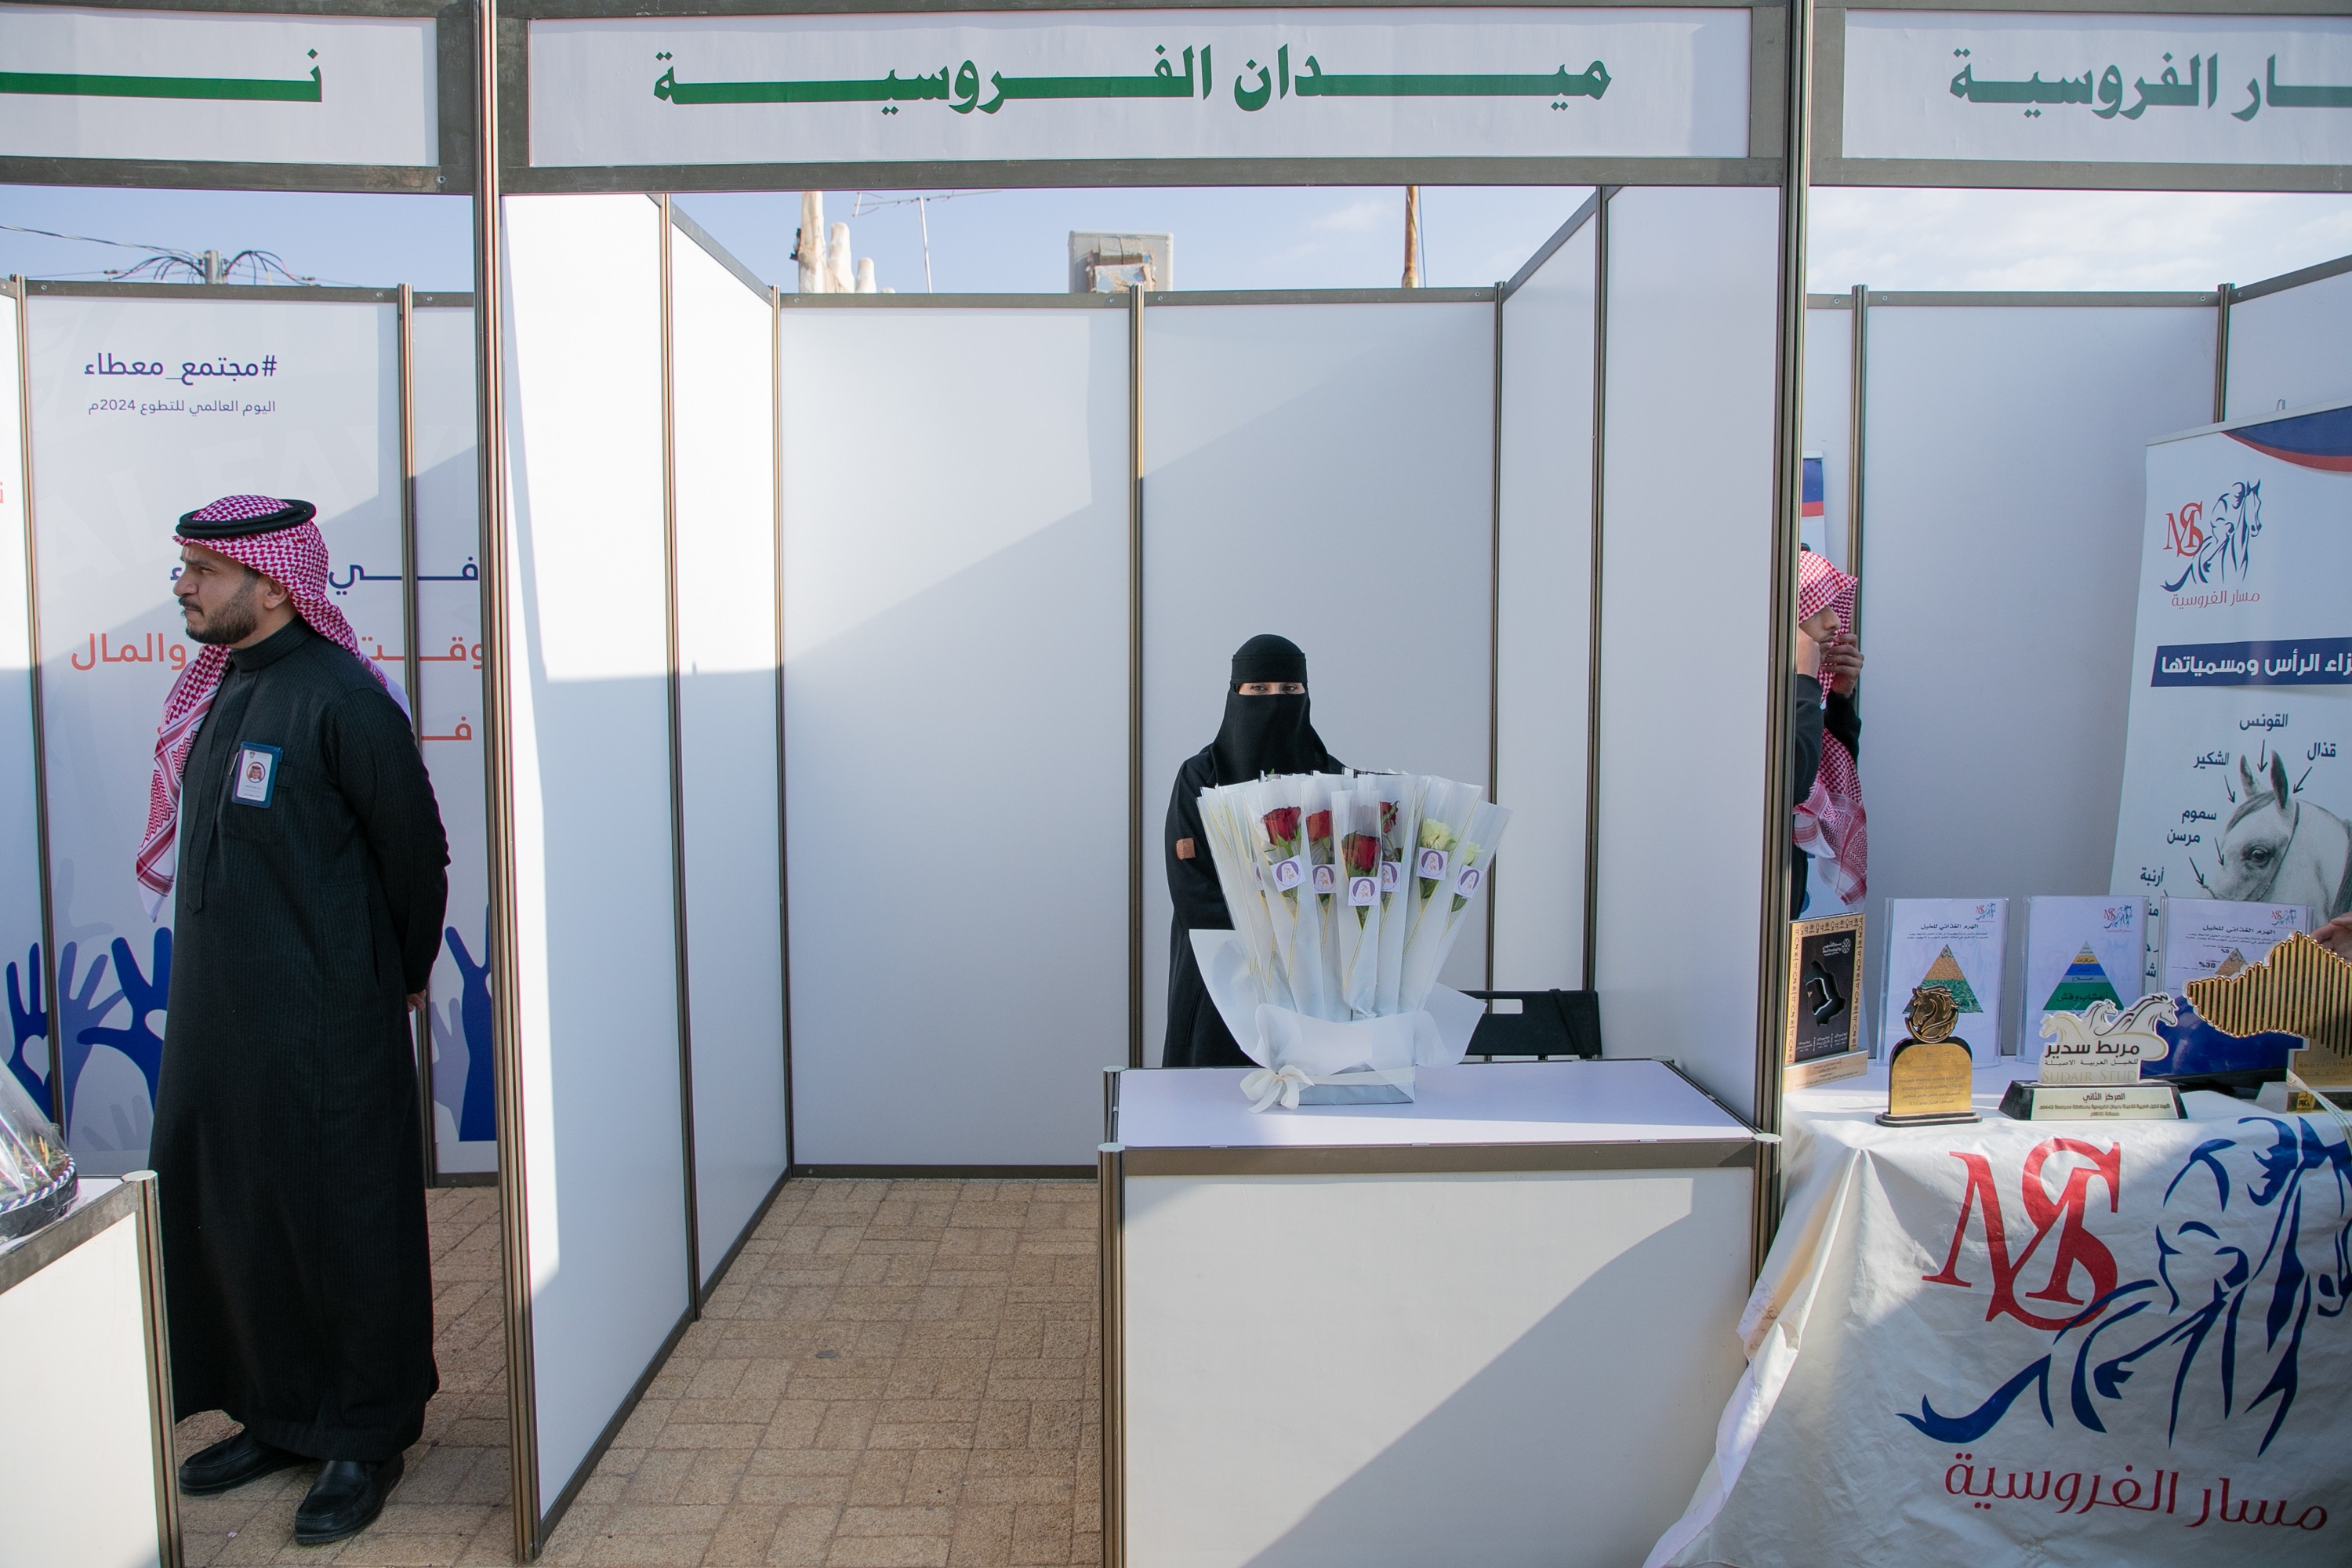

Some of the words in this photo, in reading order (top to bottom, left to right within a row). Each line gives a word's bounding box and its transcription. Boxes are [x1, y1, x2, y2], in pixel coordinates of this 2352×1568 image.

[654, 44, 1212, 115] الفروسية
[1234, 43, 1613, 111] ميدان
[1950, 49, 2218, 120] الفروسية
[2231, 53, 2352, 122] ار
[84, 352, 278, 386] #مجتمع_معطاء
[88, 399, 136, 415] 2024م
[140, 400, 185, 416] للتطوع
[189, 401, 238, 416] العالمي
[243, 401, 276, 415] اليوم
[2172, 590, 2227, 610] الفروسية
[2230, 590, 2260, 607] مسار
[71, 633, 187, 670] والمال
[2161, 655, 2259, 677] ومسمياتها
[2264, 648, 2320, 676] الرأس
[2325, 652, 2352, 676] زاء
[2239, 713, 2288, 731] القونس
[2193, 751, 2229, 769] الشكير
[2307, 742, 2336, 760] قذال
[2181, 809, 2216, 824] سموم
[2166, 829, 2200, 846] مرسن
[2140, 866, 2164, 887] أرنبة
[2045, 1044, 2091, 1059] سدير
[2095, 1040, 2140, 1058] مربط
[2042, 1070, 2093, 1083] SUDAIR
[2100, 1069, 2137, 1082] STUD
[2082, 1091, 2102, 1103] الثاني
[2105, 1092, 2125, 1102] المركز
[1944, 1452, 2180, 1516] الفروسية
[2184, 1477, 2328, 1531] مسار
